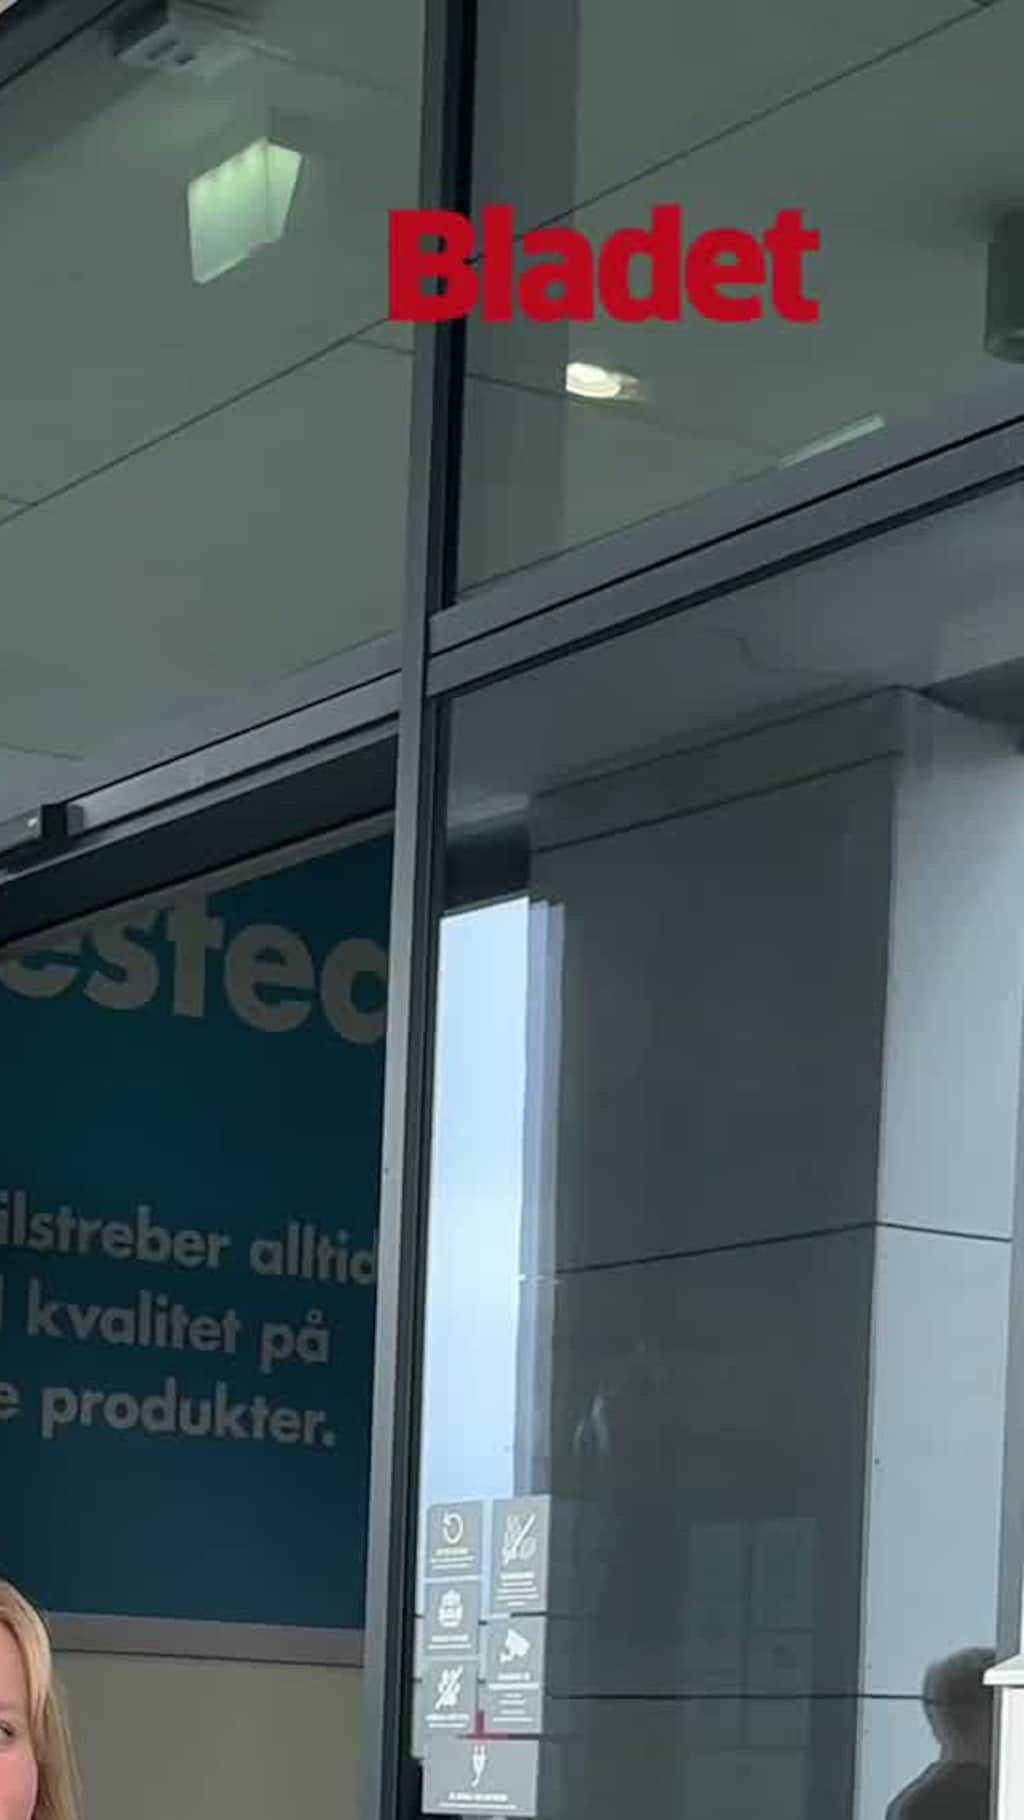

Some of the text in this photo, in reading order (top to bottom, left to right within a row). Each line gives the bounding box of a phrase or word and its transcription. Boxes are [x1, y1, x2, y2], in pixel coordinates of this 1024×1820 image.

[26, 1278, 242, 1355] kvalitet
[260, 1308, 331, 1373] på
[41, 1376, 337, 1447] produkter.
